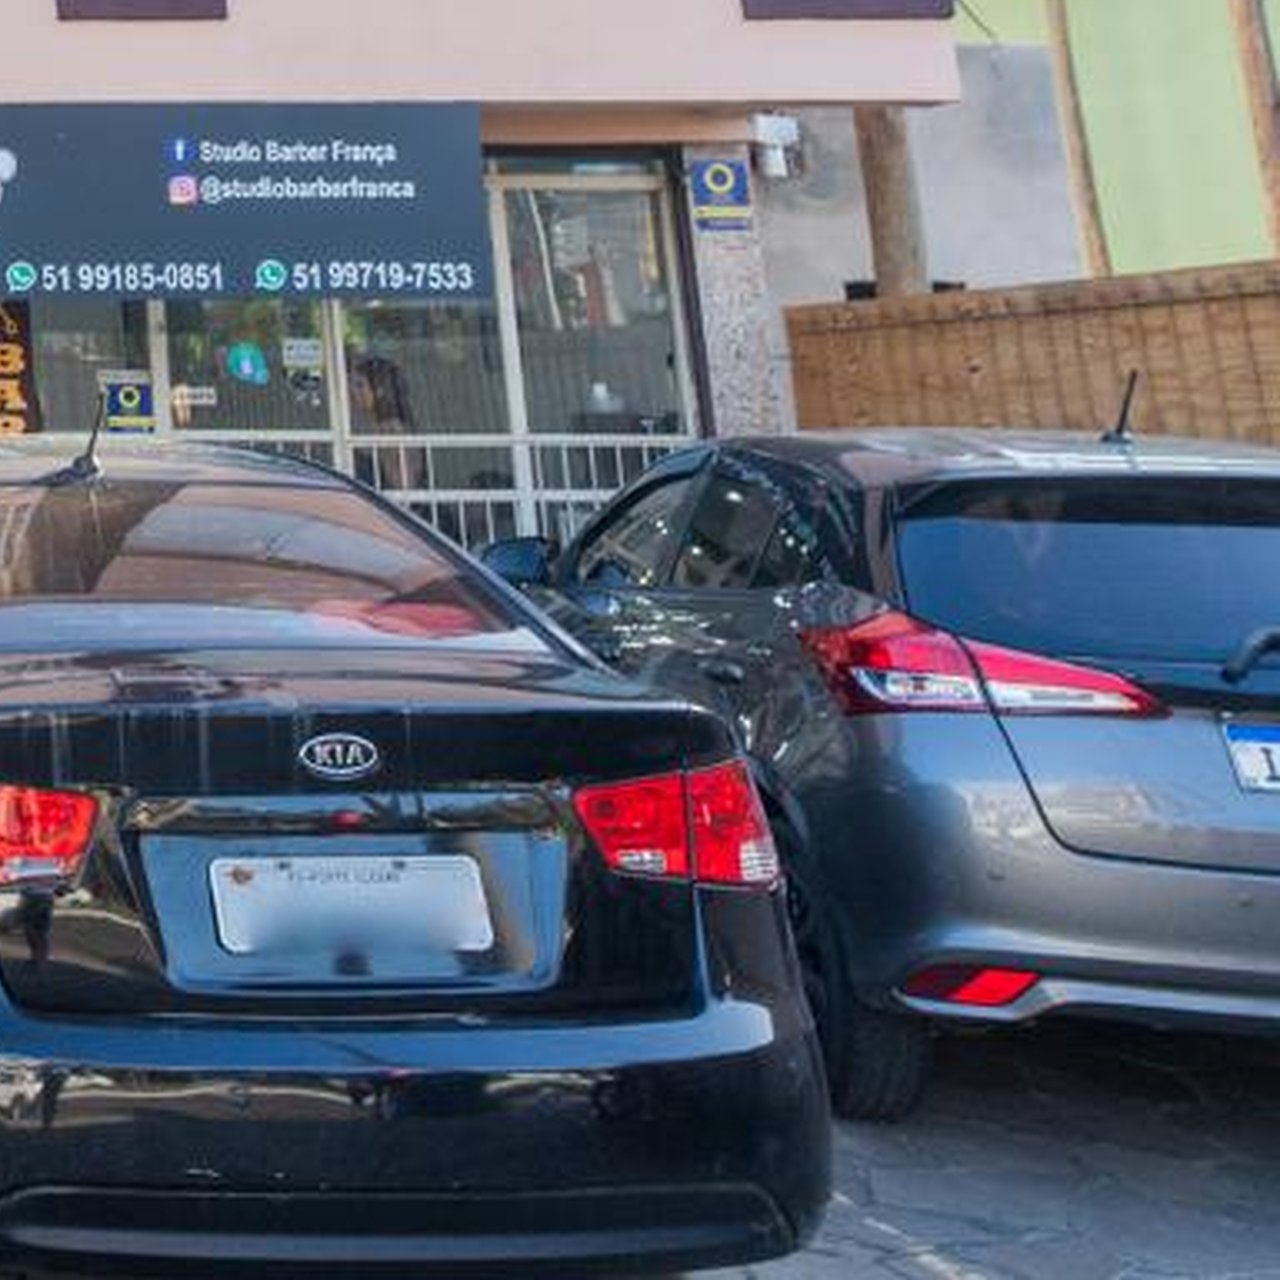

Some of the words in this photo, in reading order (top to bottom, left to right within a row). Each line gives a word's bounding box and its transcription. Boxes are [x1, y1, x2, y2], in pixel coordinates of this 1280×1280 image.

[199, 140, 261, 162] Studio
[265, 140, 328, 162] Barber
[332, 139, 397, 168] França
[200, 175, 415, 205] @studiobarberfranca
[42, 263, 71, 292] 51
[78, 262, 223, 292] 99185-0851
[293, 261, 322, 290] 51
[328, 260, 474, 291] 99719-7533
[314, 743, 365, 766] KIA
